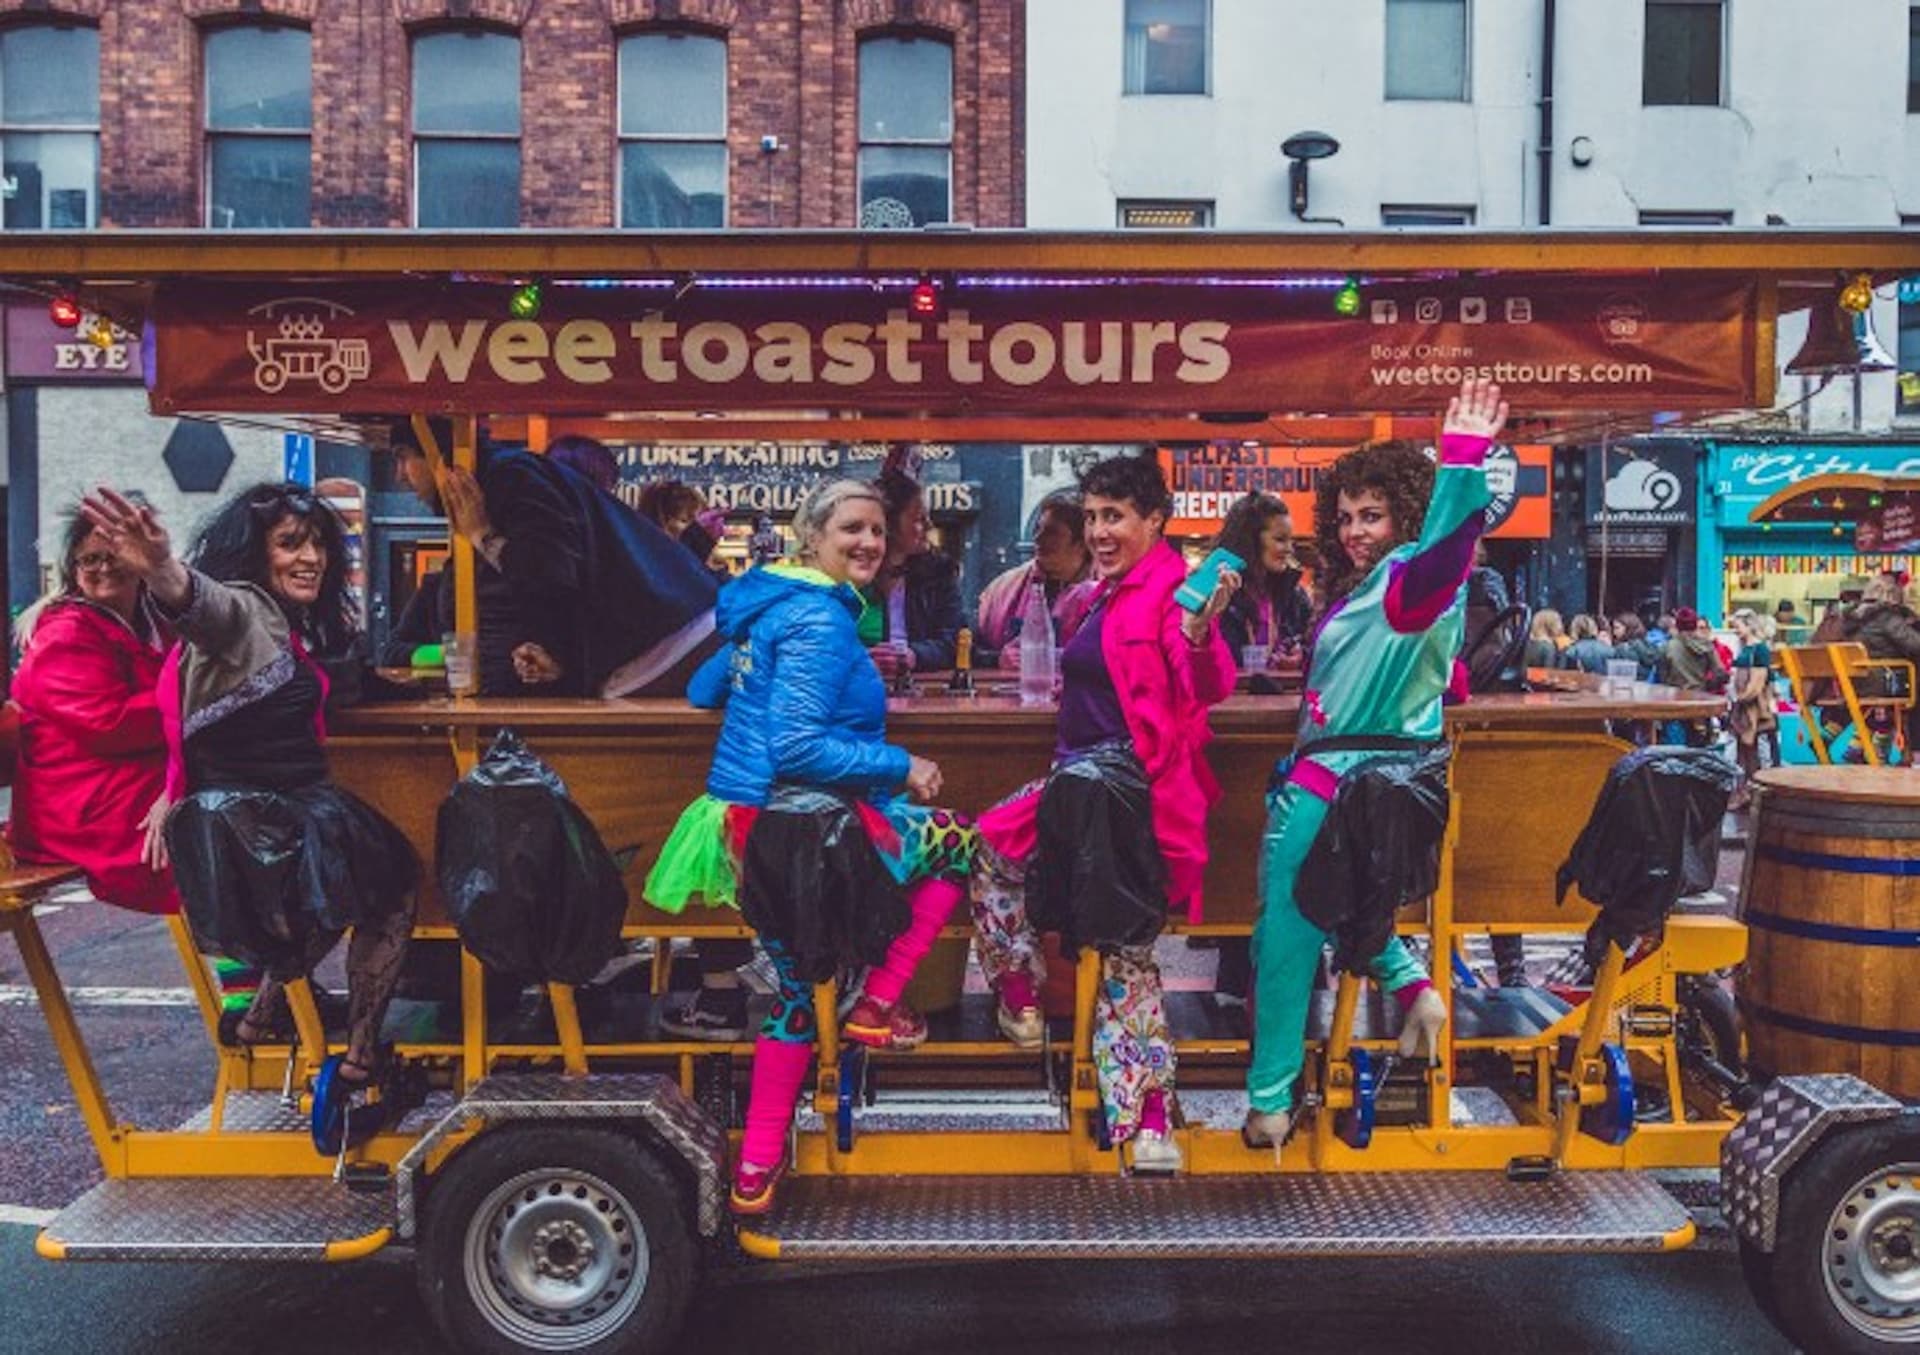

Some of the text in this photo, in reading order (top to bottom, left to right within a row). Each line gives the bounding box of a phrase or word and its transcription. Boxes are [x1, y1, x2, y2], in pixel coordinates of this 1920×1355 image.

[54, 342, 129, 369] EYE
[387, 308, 1231, 385] wee toast tours
[1371, 344, 1473, 361] Book Online
[1371, 361, 1652, 385] weetoasttours.com
[1173, 466, 1321, 491] UNDERGROU
